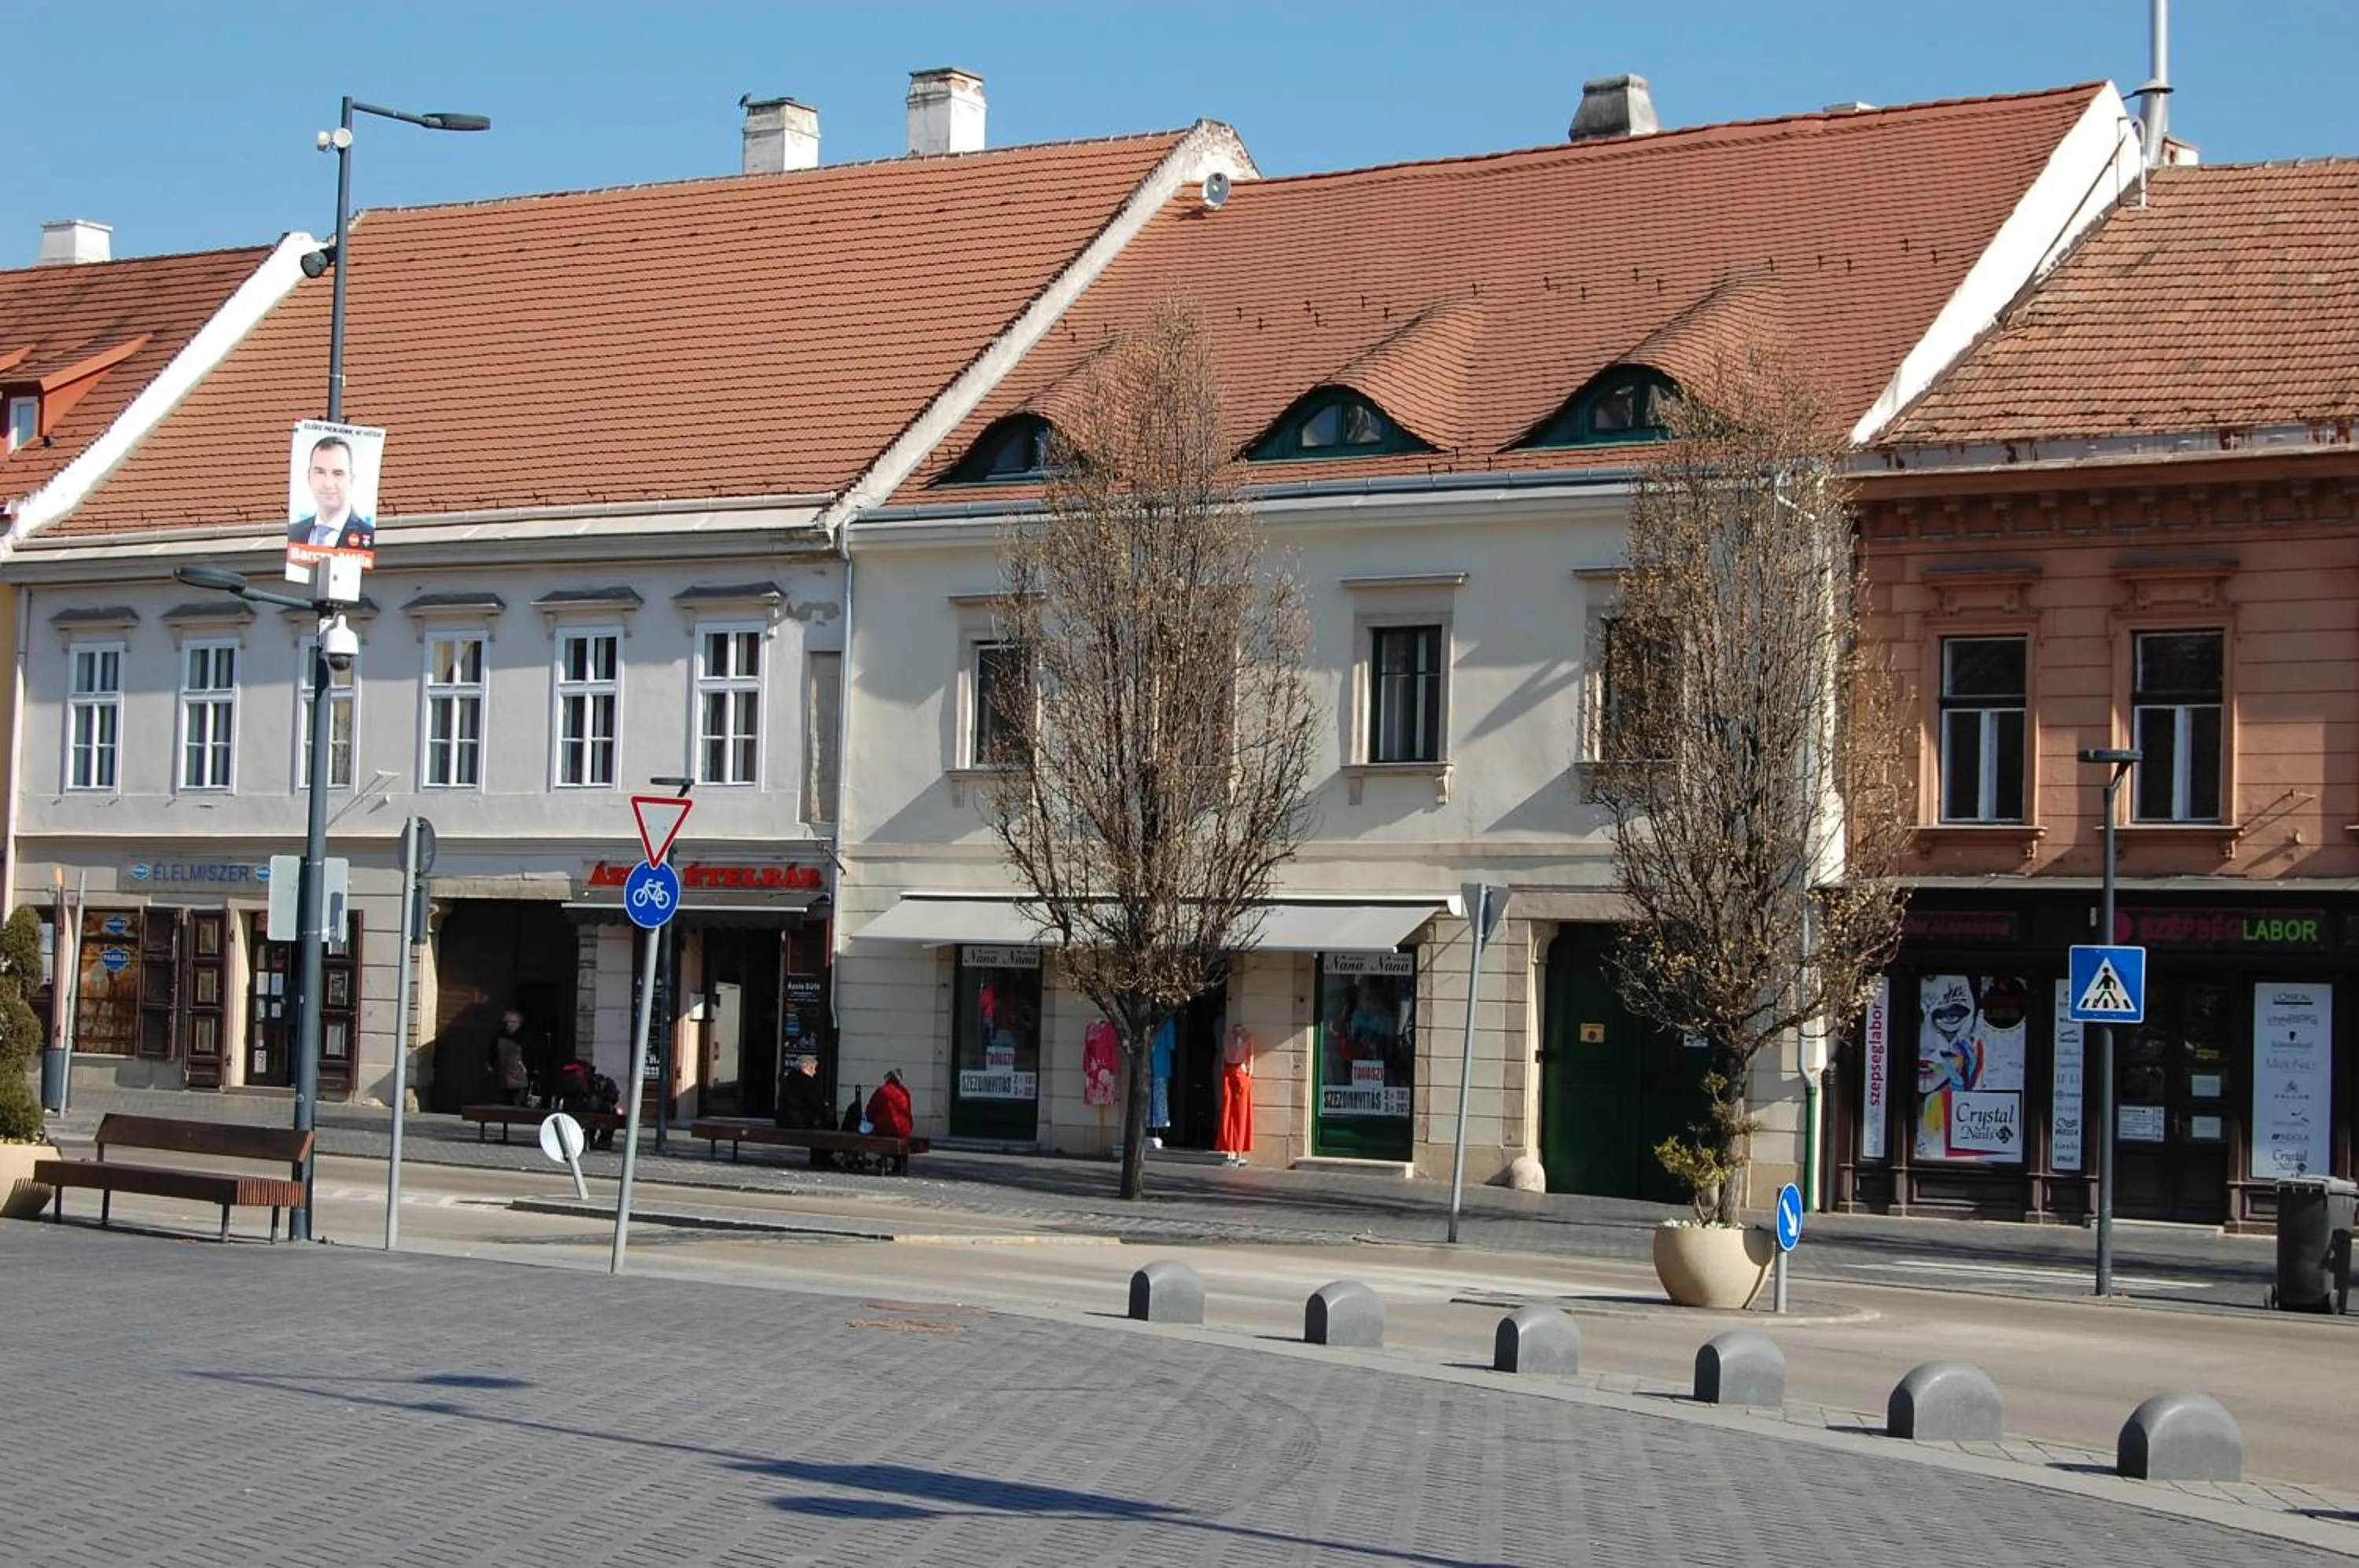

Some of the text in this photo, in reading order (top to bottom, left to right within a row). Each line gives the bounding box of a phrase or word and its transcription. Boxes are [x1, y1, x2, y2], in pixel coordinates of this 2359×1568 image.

[153, 861, 250, 882] ÉLELMISZER
[683, 861, 823, 887] ÉTELBÁR
[1868, 1003, 1884, 1107] szepseglabor
[1956, 1102, 2015, 1130] Crystal
